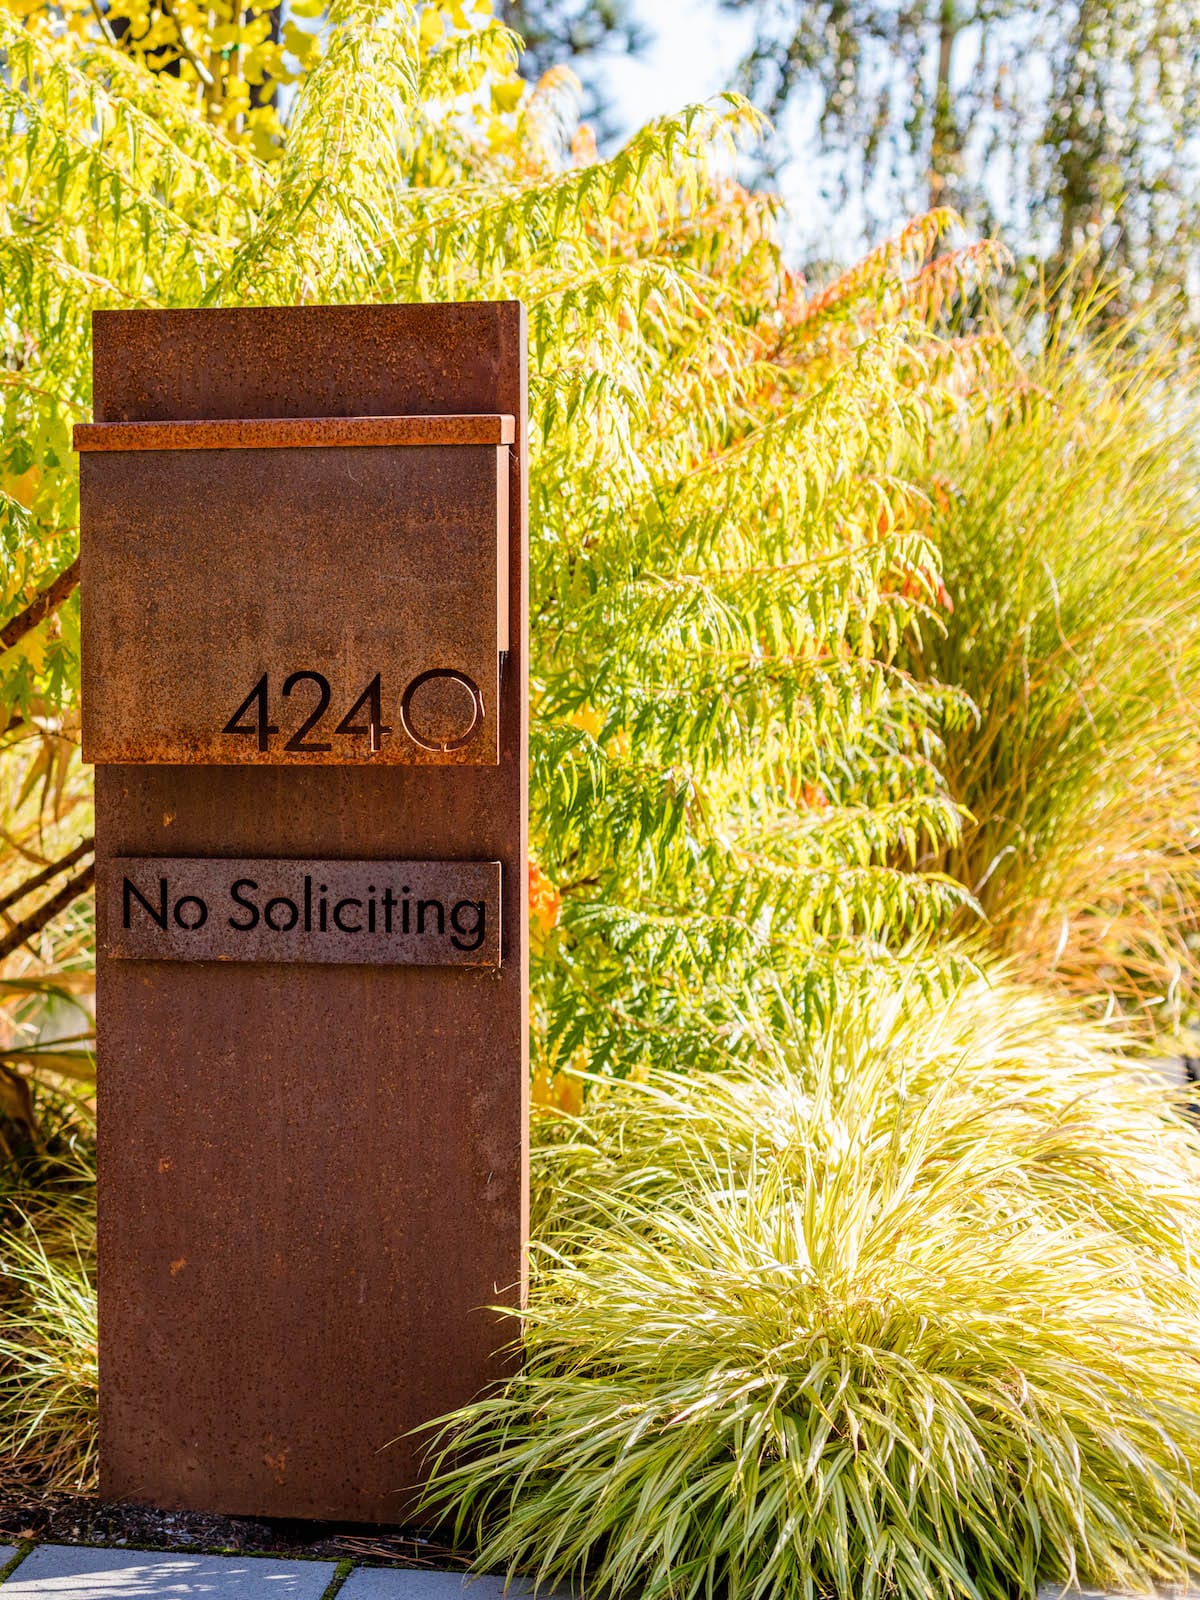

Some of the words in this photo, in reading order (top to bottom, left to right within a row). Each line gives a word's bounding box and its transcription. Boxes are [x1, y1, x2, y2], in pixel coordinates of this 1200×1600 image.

[221, 668, 486, 753] 4240
[122, 876, 209, 931] No
[228, 875, 486, 952] Soliciting
